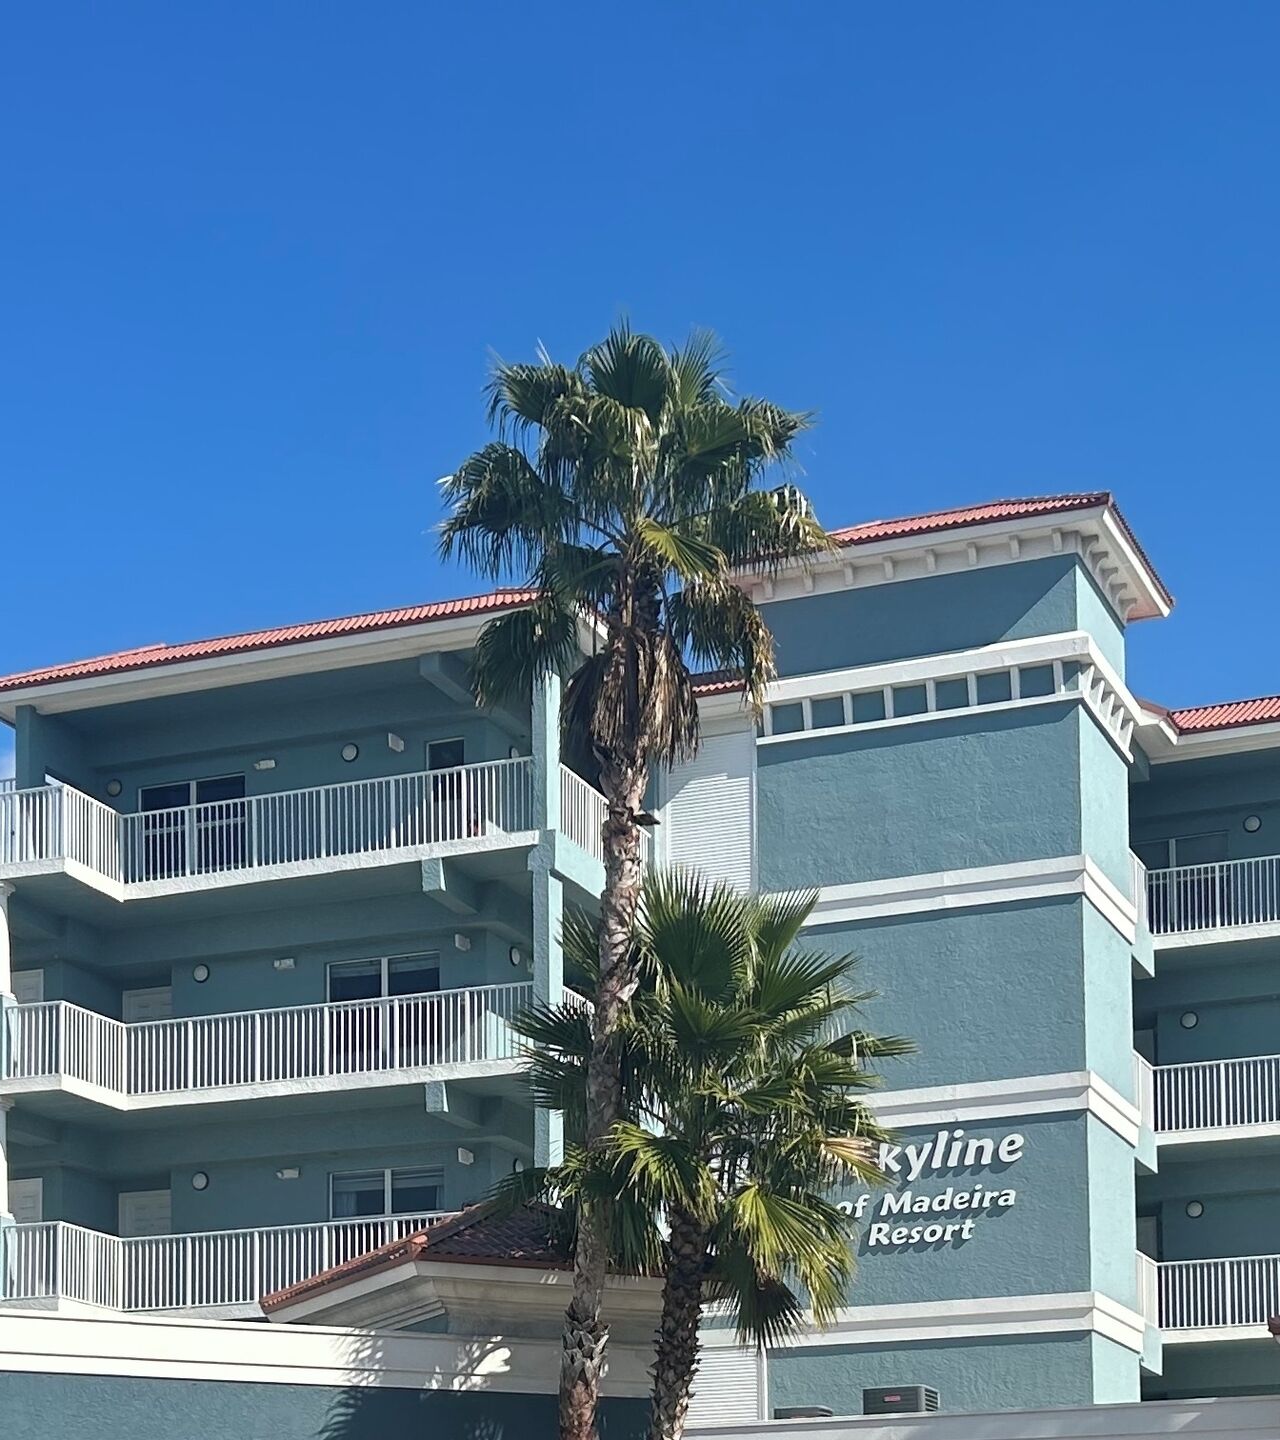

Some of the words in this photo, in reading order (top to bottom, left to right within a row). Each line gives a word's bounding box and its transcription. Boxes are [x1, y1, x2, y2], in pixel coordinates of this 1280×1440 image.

[878, 1129, 1025, 1182] kyline
[836, 1194, 870, 1218] of
[879, 1184, 1016, 1216] Madeira
[868, 1219, 976, 1247] Resort
